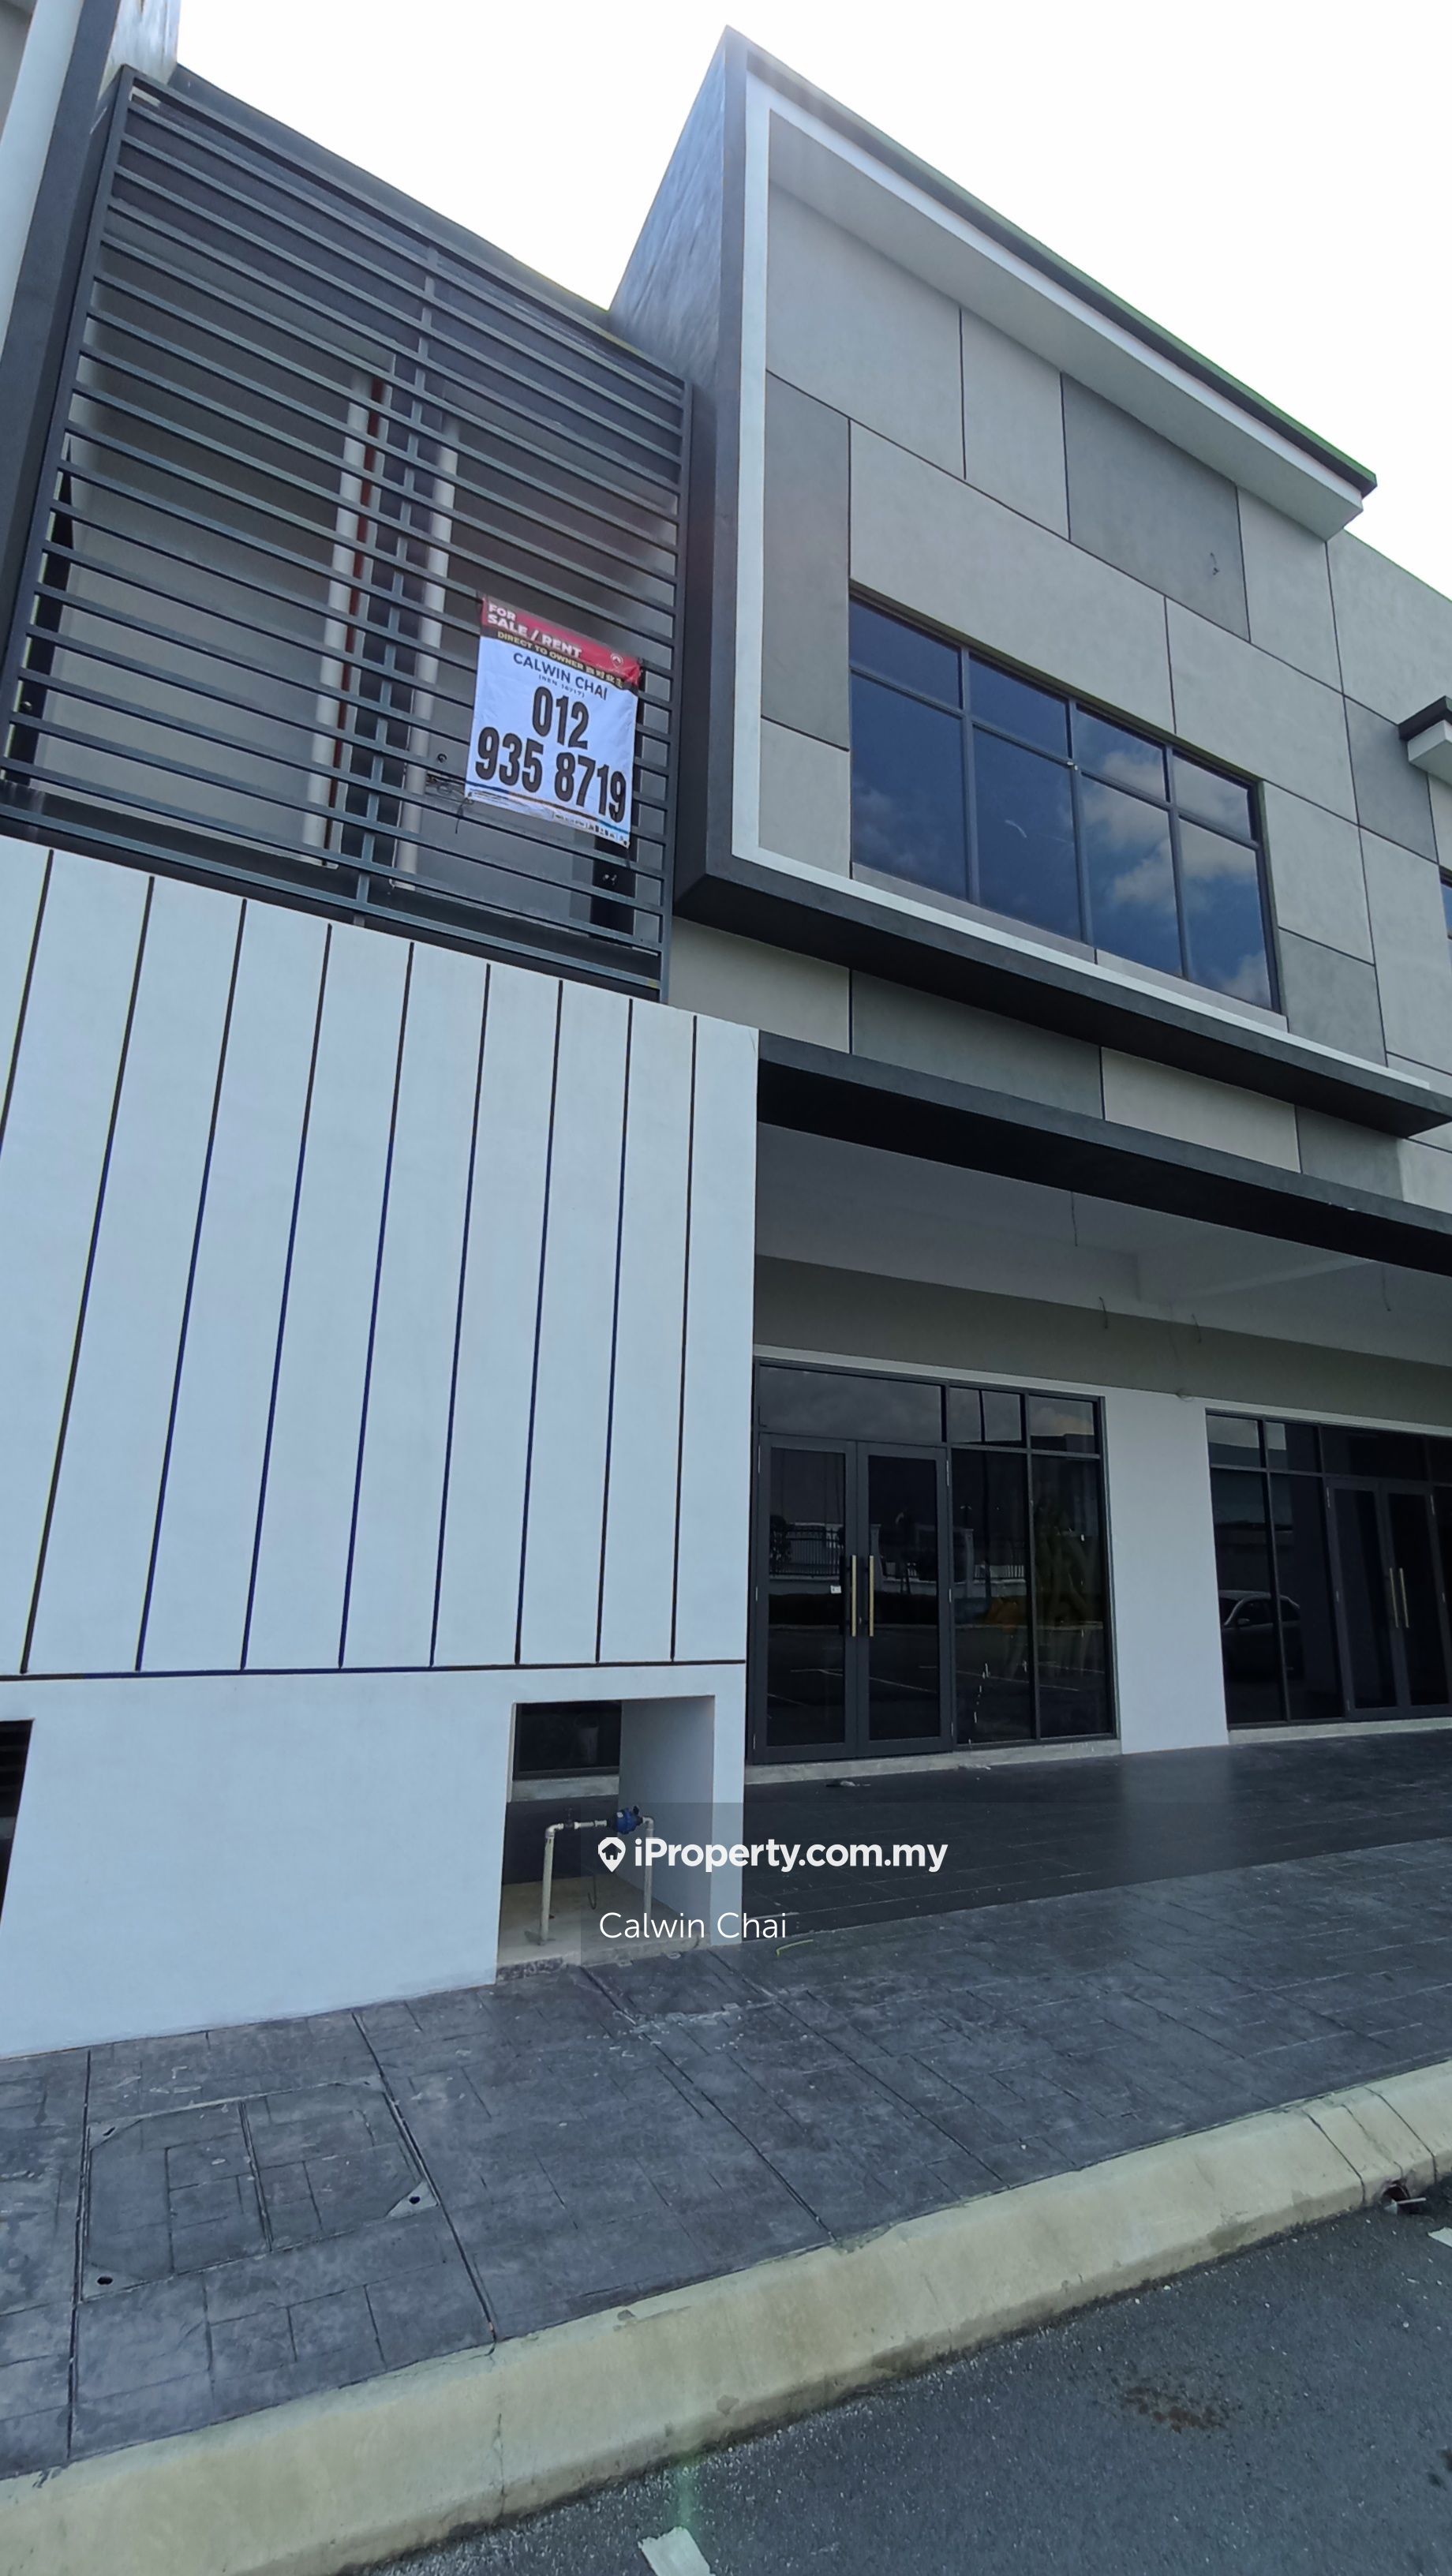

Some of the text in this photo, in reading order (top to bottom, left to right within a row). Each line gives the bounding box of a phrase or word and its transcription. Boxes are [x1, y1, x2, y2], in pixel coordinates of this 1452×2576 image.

[488, 603, 516, 621] FOR
[488, 613, 528, 639] SALE
[541, 634, 582, 658] RENT
[498, 631, 533, 650] DIRECT
[534, 644, 548, 656] TO
[549, 651, 584, 669] OWNER
[513, 652, 571, 683] CALWIN
[575, 676, 608, 701] CHAI
[532, 687, 589, 750] 012
[475, 727, 627, 823] 935 8719
